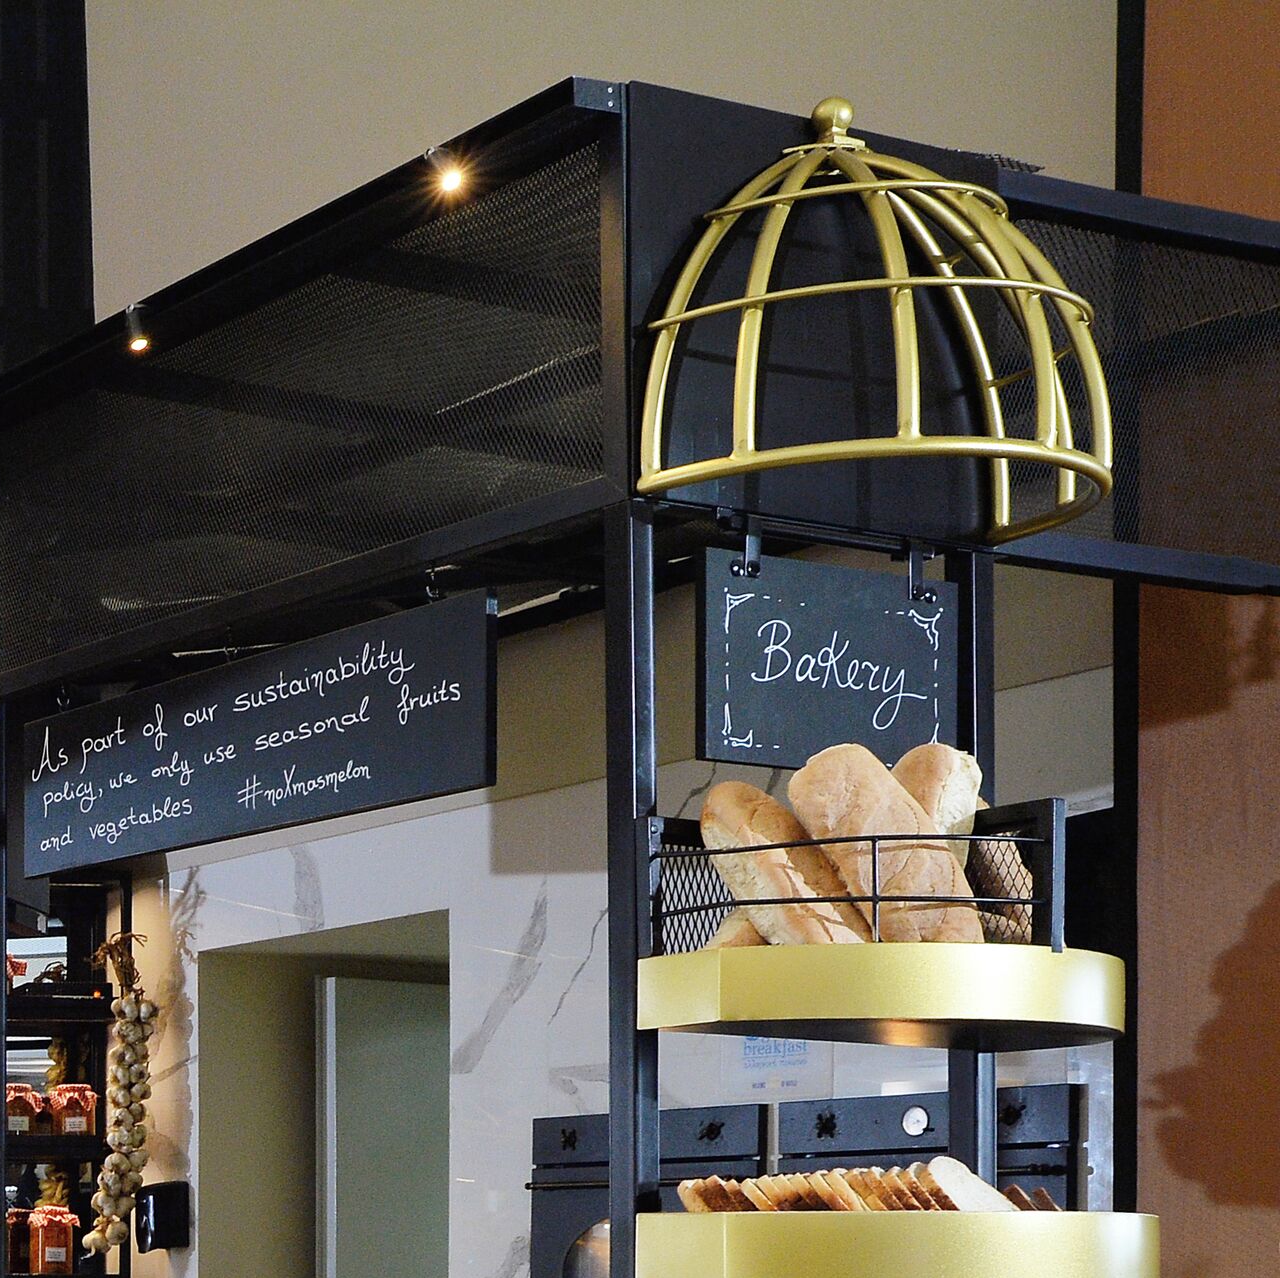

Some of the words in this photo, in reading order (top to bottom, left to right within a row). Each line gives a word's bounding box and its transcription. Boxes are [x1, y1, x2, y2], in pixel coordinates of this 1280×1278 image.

[31, 726, 69, 782] As
[79, 716, 127, 775] part
[142, 703, 169, 751] of
[183, 704, 218, 727] our
[233, 639, 415, 712] sustainability
[42, 779, 103, 819] policy,
[109, 772, 138, 789] we
[151, 751, 195, 786] only
[203, 744, 237, 765] use
[255, 695, 371, 751] seasonal
[396, 679, 462, 726] fruits
[40, 825, 74, 851] and
[89, 796, 193, 845] vegetables
